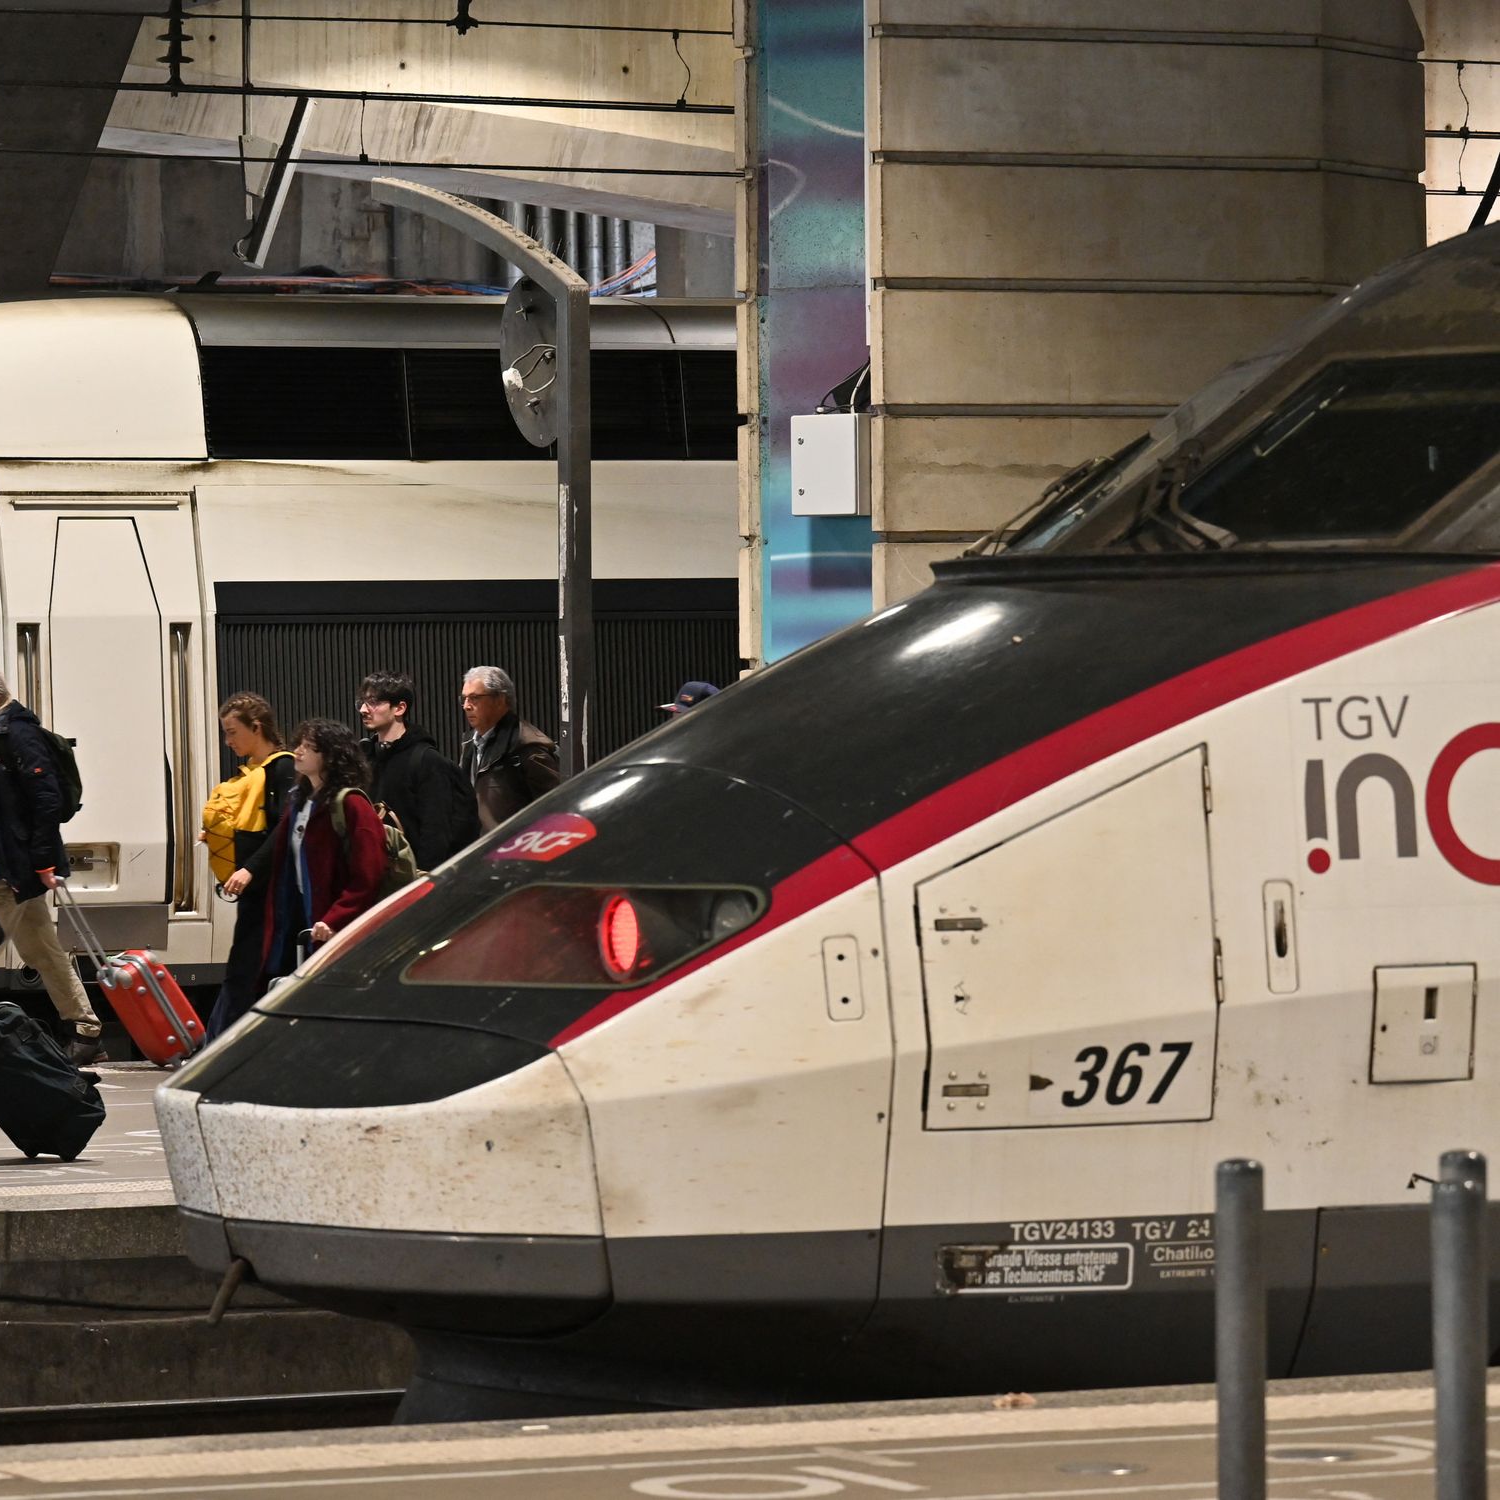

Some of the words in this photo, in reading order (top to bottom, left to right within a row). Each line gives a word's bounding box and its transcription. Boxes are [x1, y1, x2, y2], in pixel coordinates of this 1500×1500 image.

[1302, 695, 1410, 741] TGV
[497, 831, 587, 853] SNCF
[1061, 1042, 1193, 1108] 367
[1010, 1220, 1115, 1241] TGV24133
[1024, 1249, 1062, 1267] Vitesse
[1002, 1266, 1076, 1284] Technicentres
[1077, 1264, 1106, 1282] SNCF
